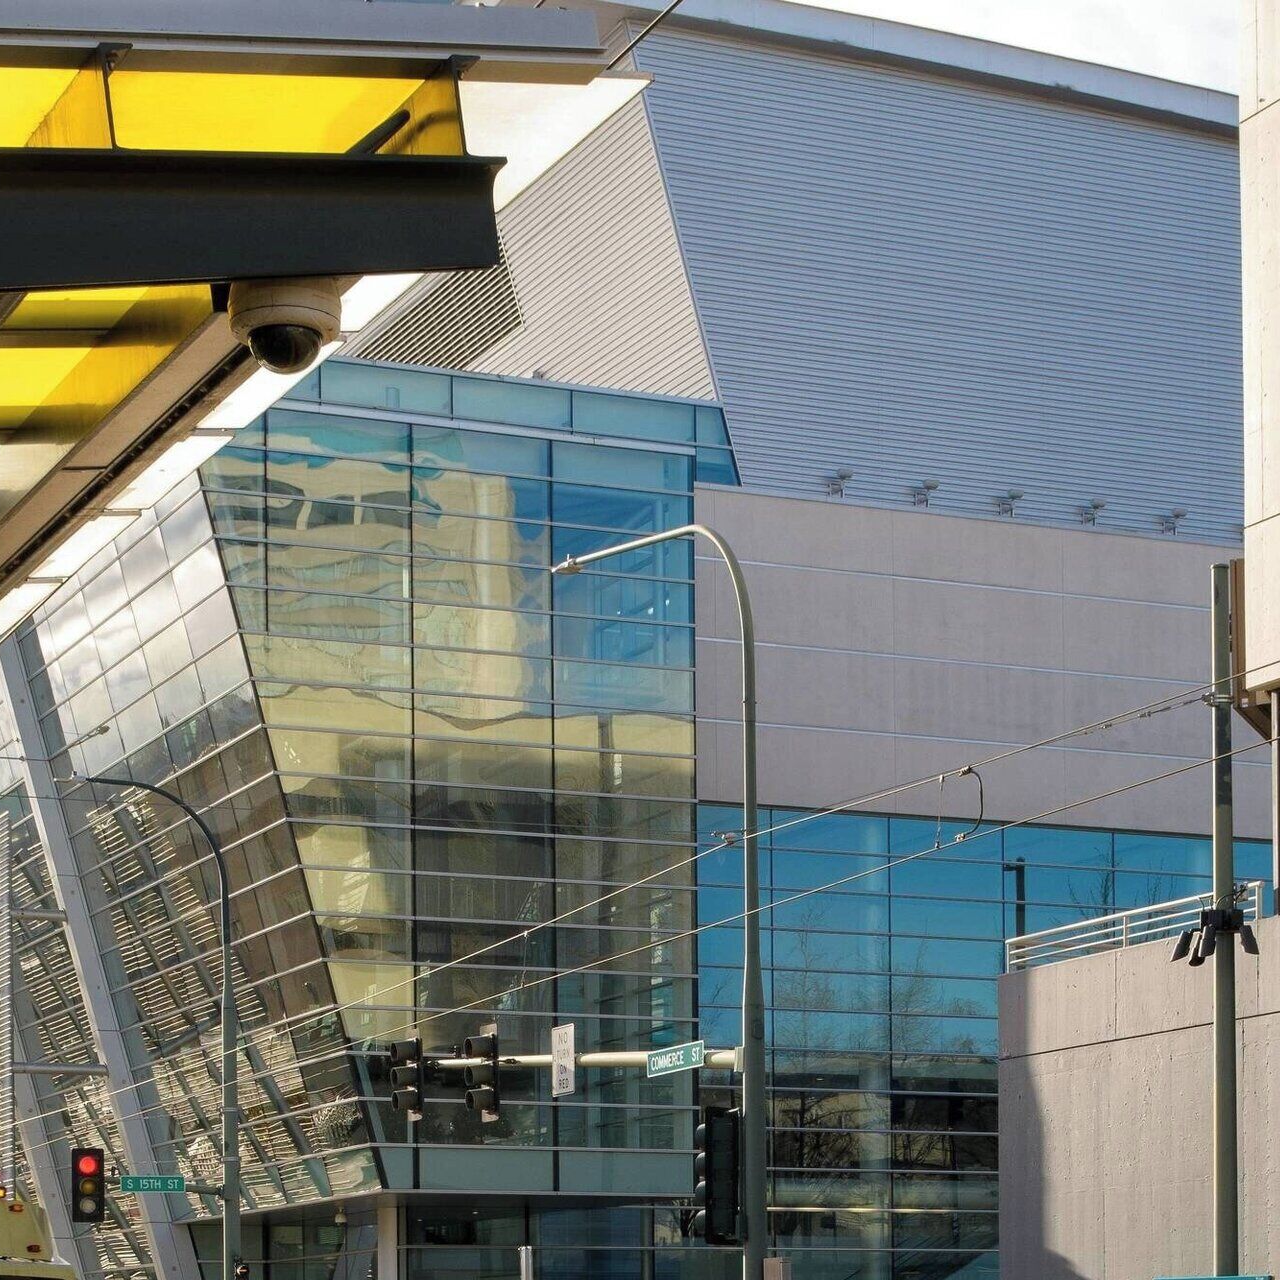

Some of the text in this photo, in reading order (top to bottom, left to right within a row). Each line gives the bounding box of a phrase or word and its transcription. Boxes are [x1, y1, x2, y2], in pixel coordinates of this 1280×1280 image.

[557, 1031, 569, 1045] NO
[650, 1047, 701, 1071] COMMERCE ST
[558, 1064, 568, 1075] ON
[557, 1078, 570, 1090] RED
[126, 1178, 180, 1190] S 15TH ST
